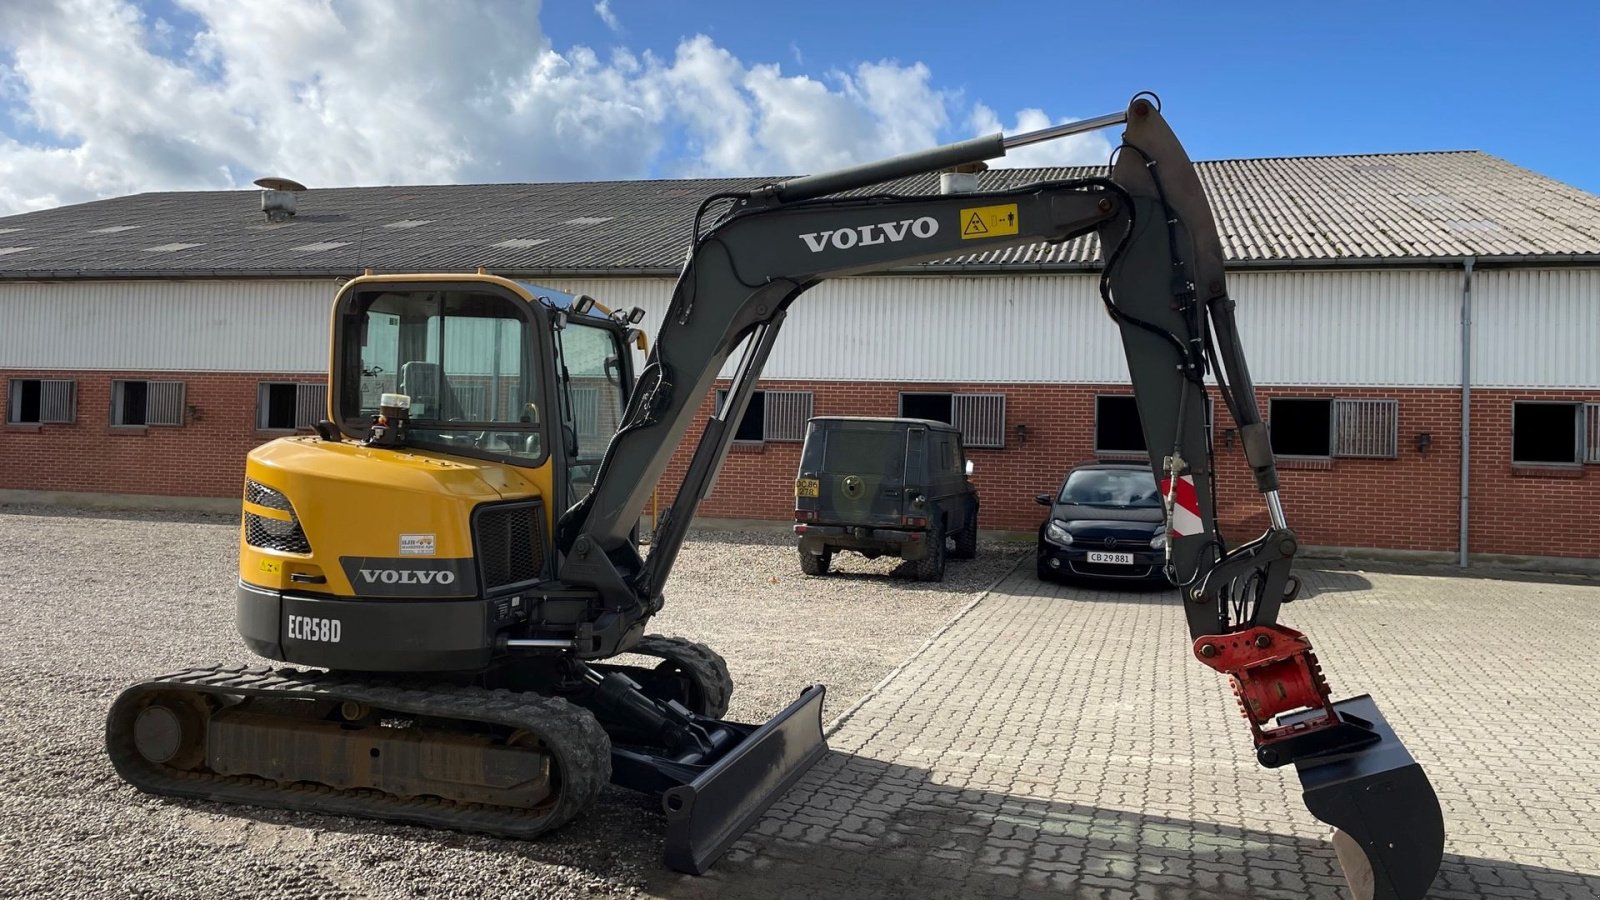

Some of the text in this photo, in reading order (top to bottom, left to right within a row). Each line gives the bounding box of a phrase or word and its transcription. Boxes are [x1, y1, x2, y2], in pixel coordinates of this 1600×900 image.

[798, 216, 939, 253] VOLVO
[799, 488, 814, 496] 278
[1090, 553, 1129, 563] CB 29 881
[359, 569, 455, 585] VOLVO
[288, 614, 341, 643] ECR58D
